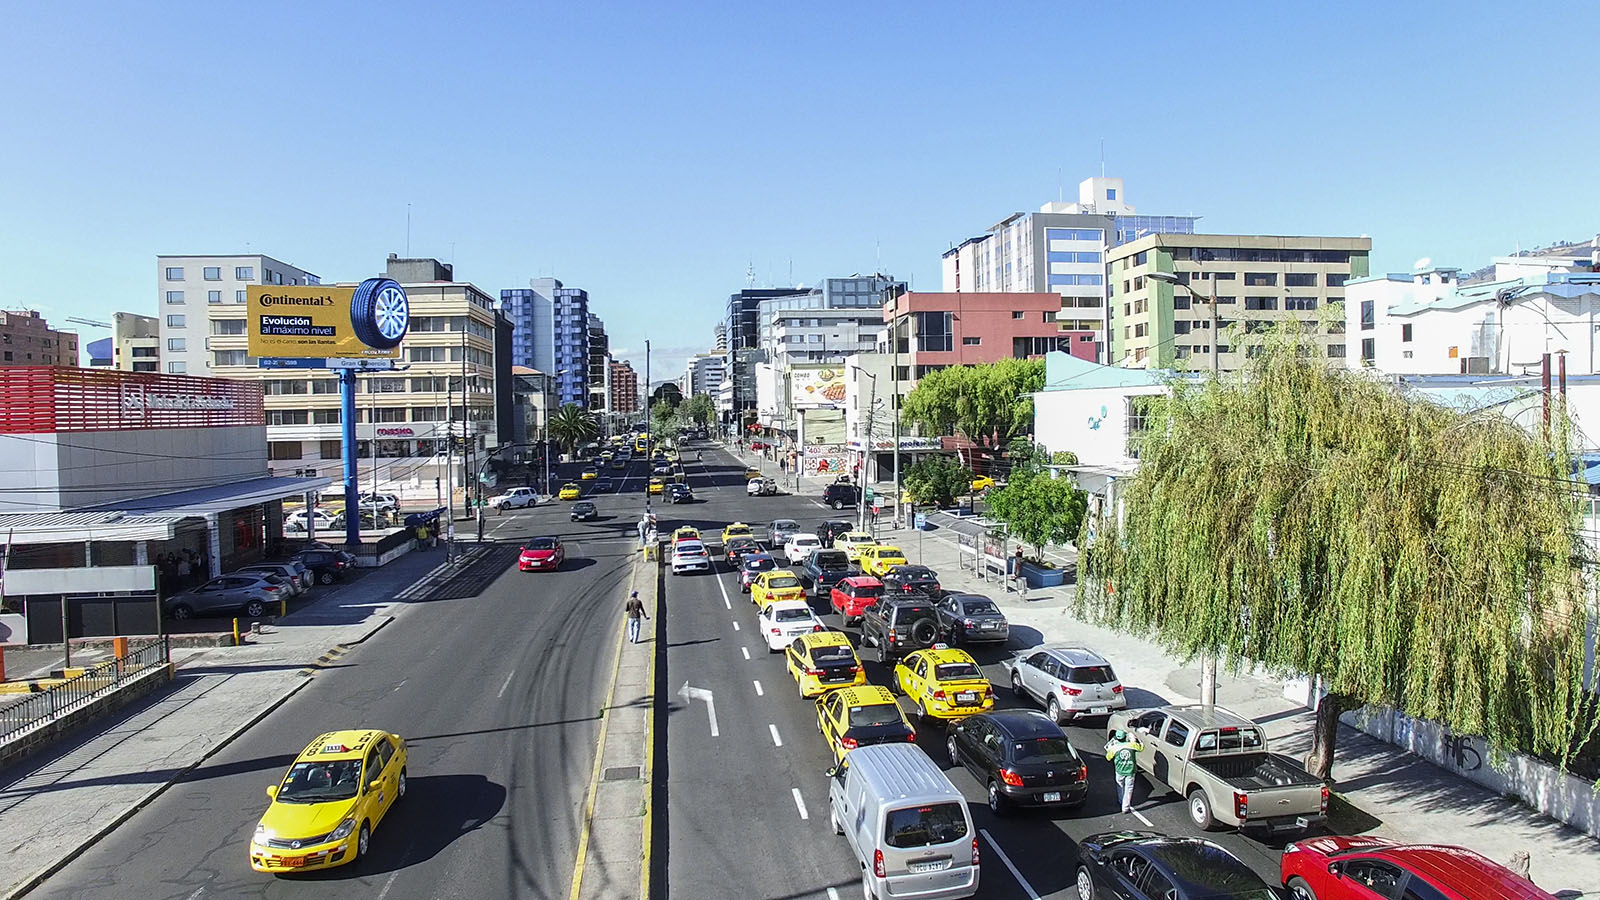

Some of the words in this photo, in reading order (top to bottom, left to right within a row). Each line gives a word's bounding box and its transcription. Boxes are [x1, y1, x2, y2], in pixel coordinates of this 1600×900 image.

[259, 293, 324, 307] Continental
[262, 316, 310, 326] Evolución
[262, 325, 271, 334] al
[272, 326, 310, 335] máximo
